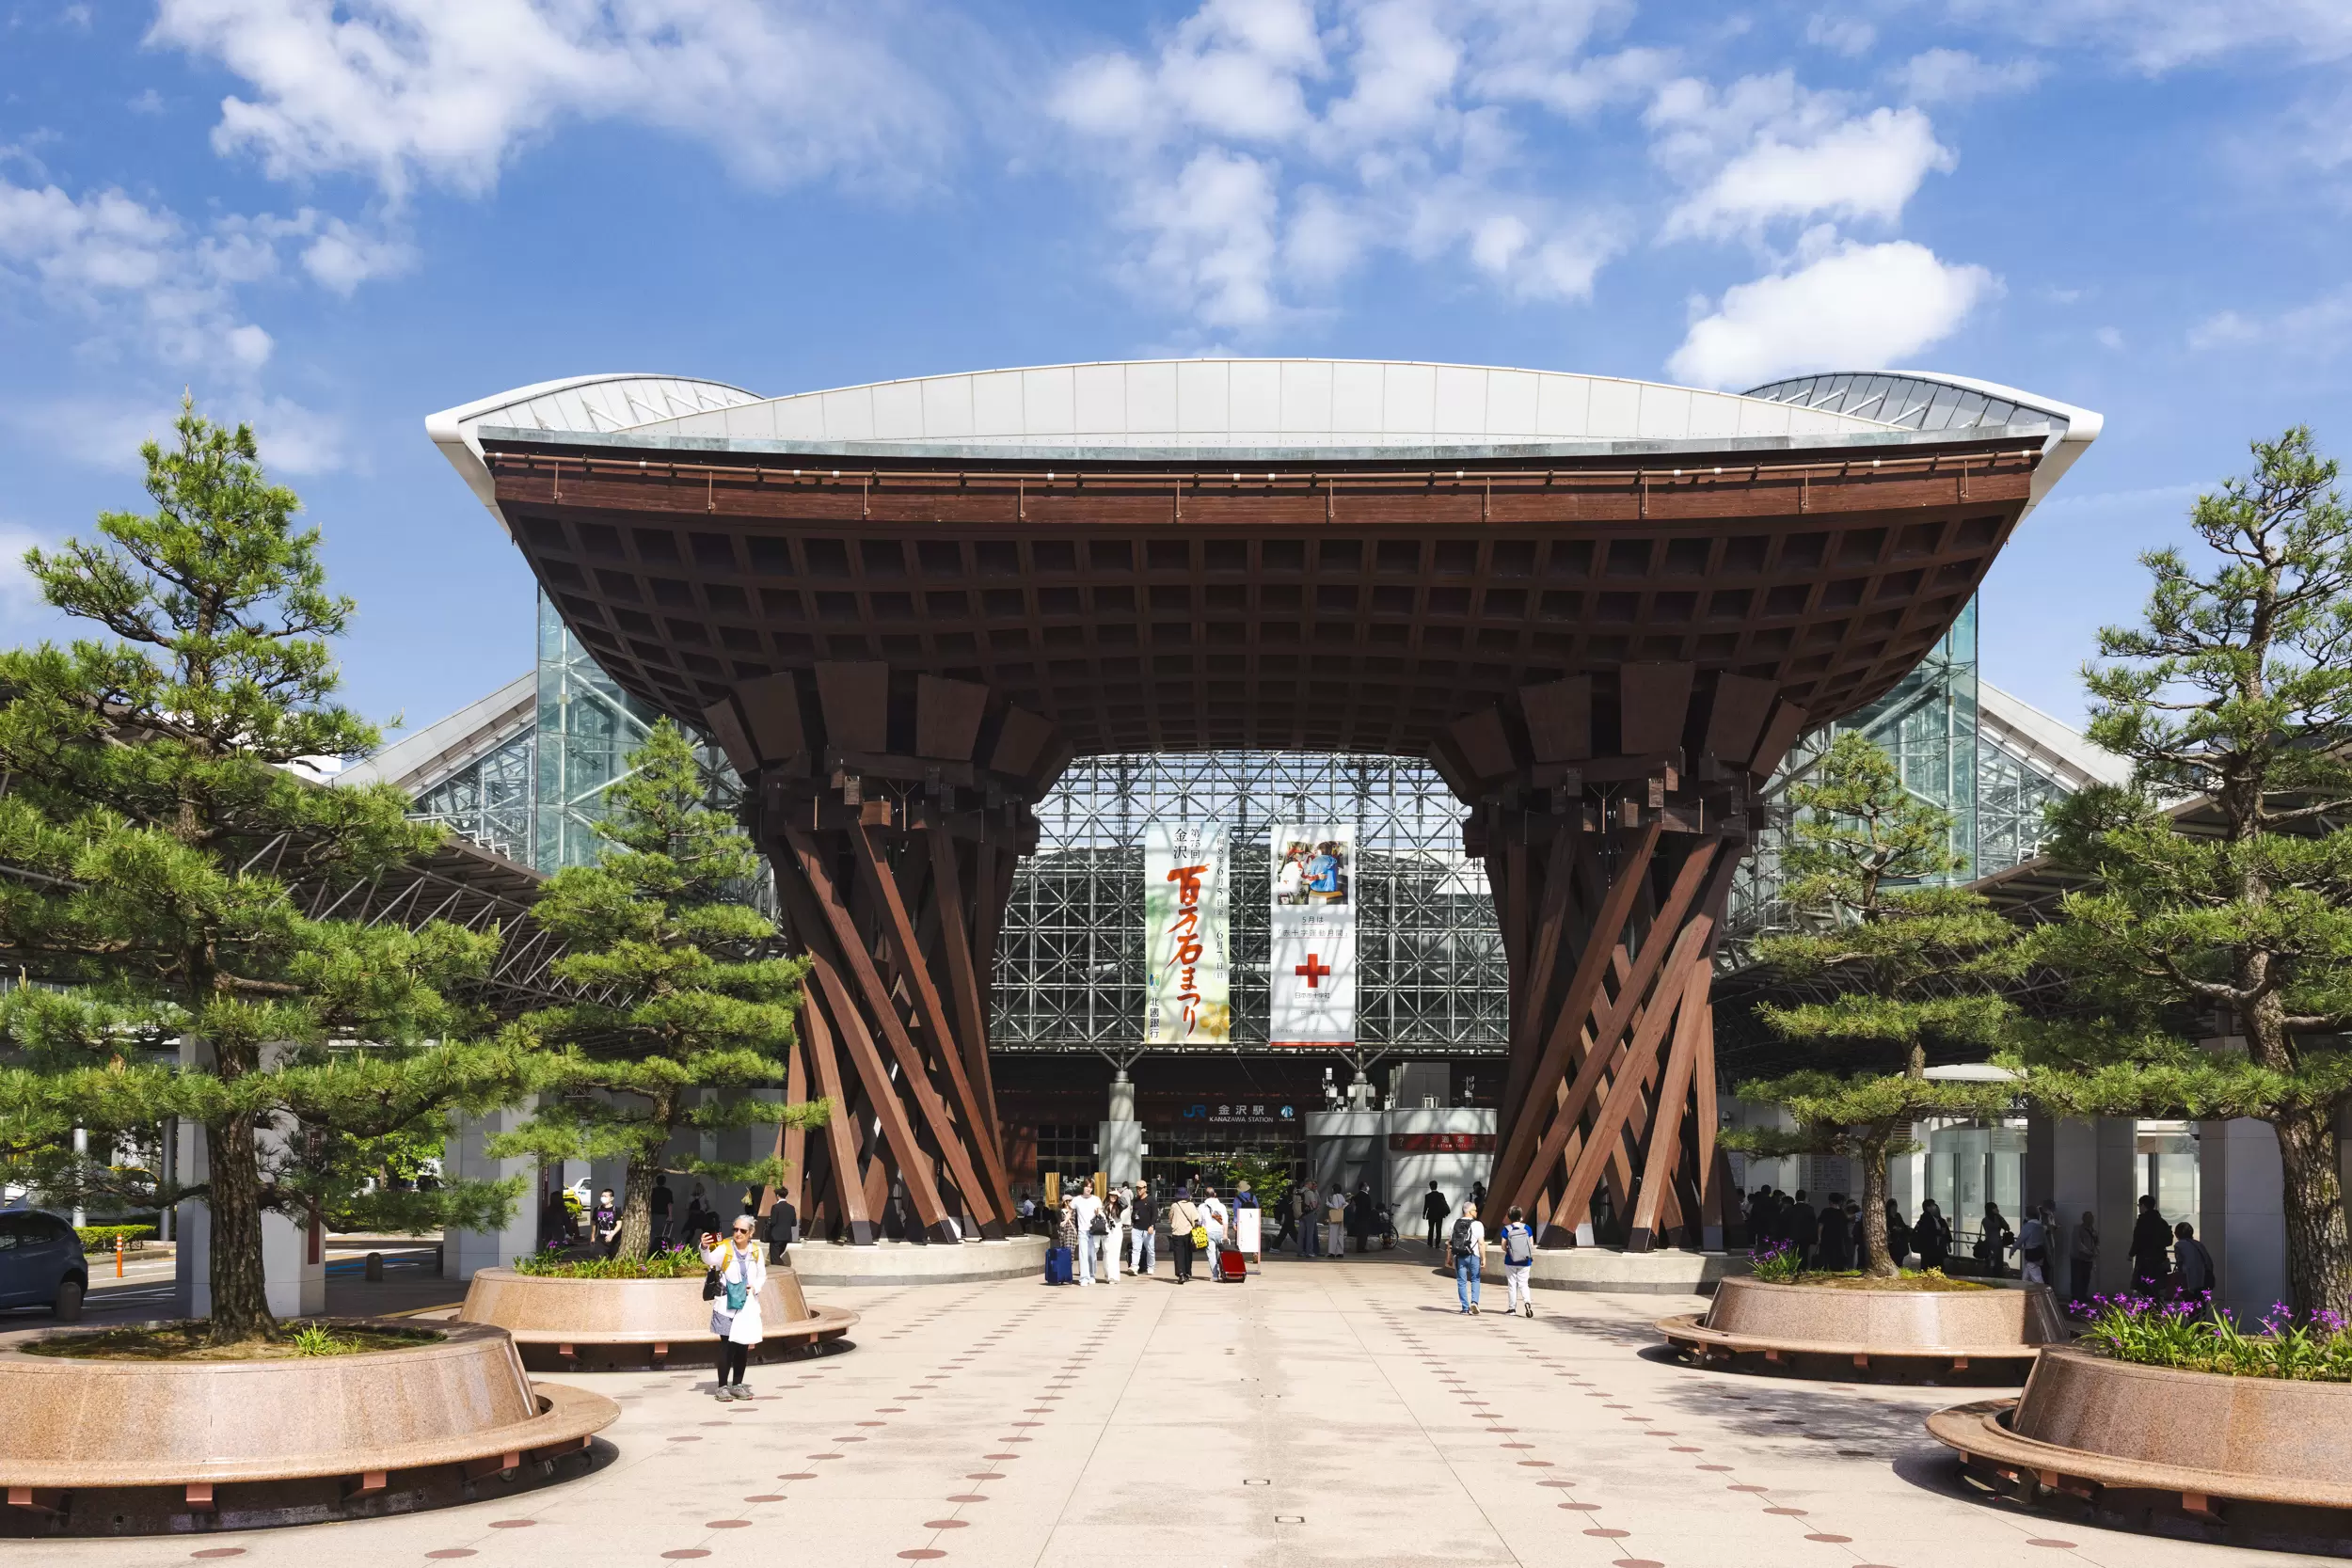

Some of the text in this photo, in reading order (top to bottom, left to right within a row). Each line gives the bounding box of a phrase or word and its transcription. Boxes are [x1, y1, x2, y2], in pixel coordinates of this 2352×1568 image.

[1173, 828, 1187, 860] 金沢
[1190, 828, 1200, 859] 第75回
[1302, 915, 1325, 924] 5月は
[1165, 863, 1211, 1037] 百万石まつり
[1149, 997, 1160, 1038] 北國銀行
[1184, 1105, 1206, 1118] JR
[1218, 1104, 1264, 1116] 金沢駅
